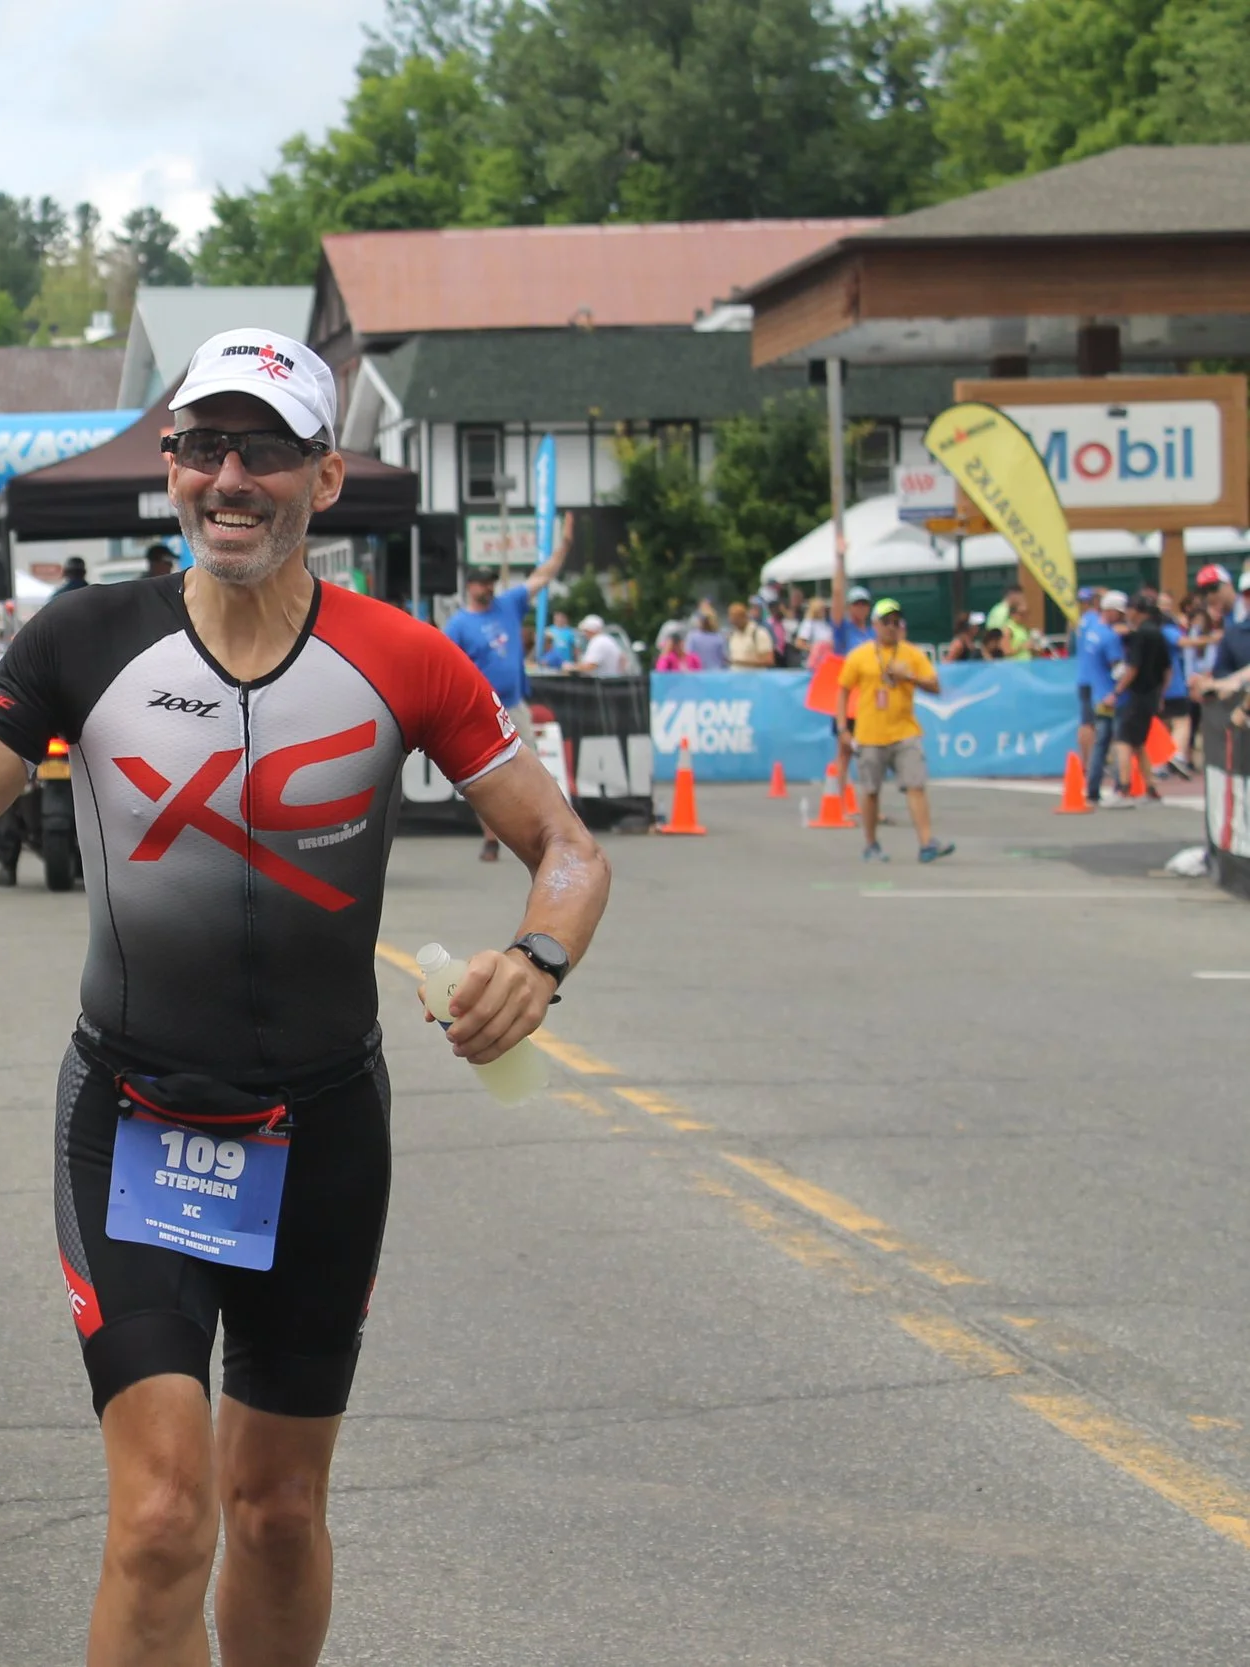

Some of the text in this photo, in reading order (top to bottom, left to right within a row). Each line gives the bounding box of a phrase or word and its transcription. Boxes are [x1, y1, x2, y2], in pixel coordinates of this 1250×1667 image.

[221, 344, 294, 370] IRONMAN
[256, 358, 293, 380] XC
[1026, 426, 1193, 482] Mobil
[696, 700, 751, 726] ONE
[111, 719, 377, 912] XC
[298, 818, 368, 850] IRONMAN
[160, 1130, 246, 1180] 109
[154, 1169, 238, 1201] STEPHEN
[181, 1203, 202, 1219] XC
[145, 1218, 237, 1247] 109 FINISHER SHIRT TICKET
[158, 1231, 220, 1255] MEN'S MEDIUM
